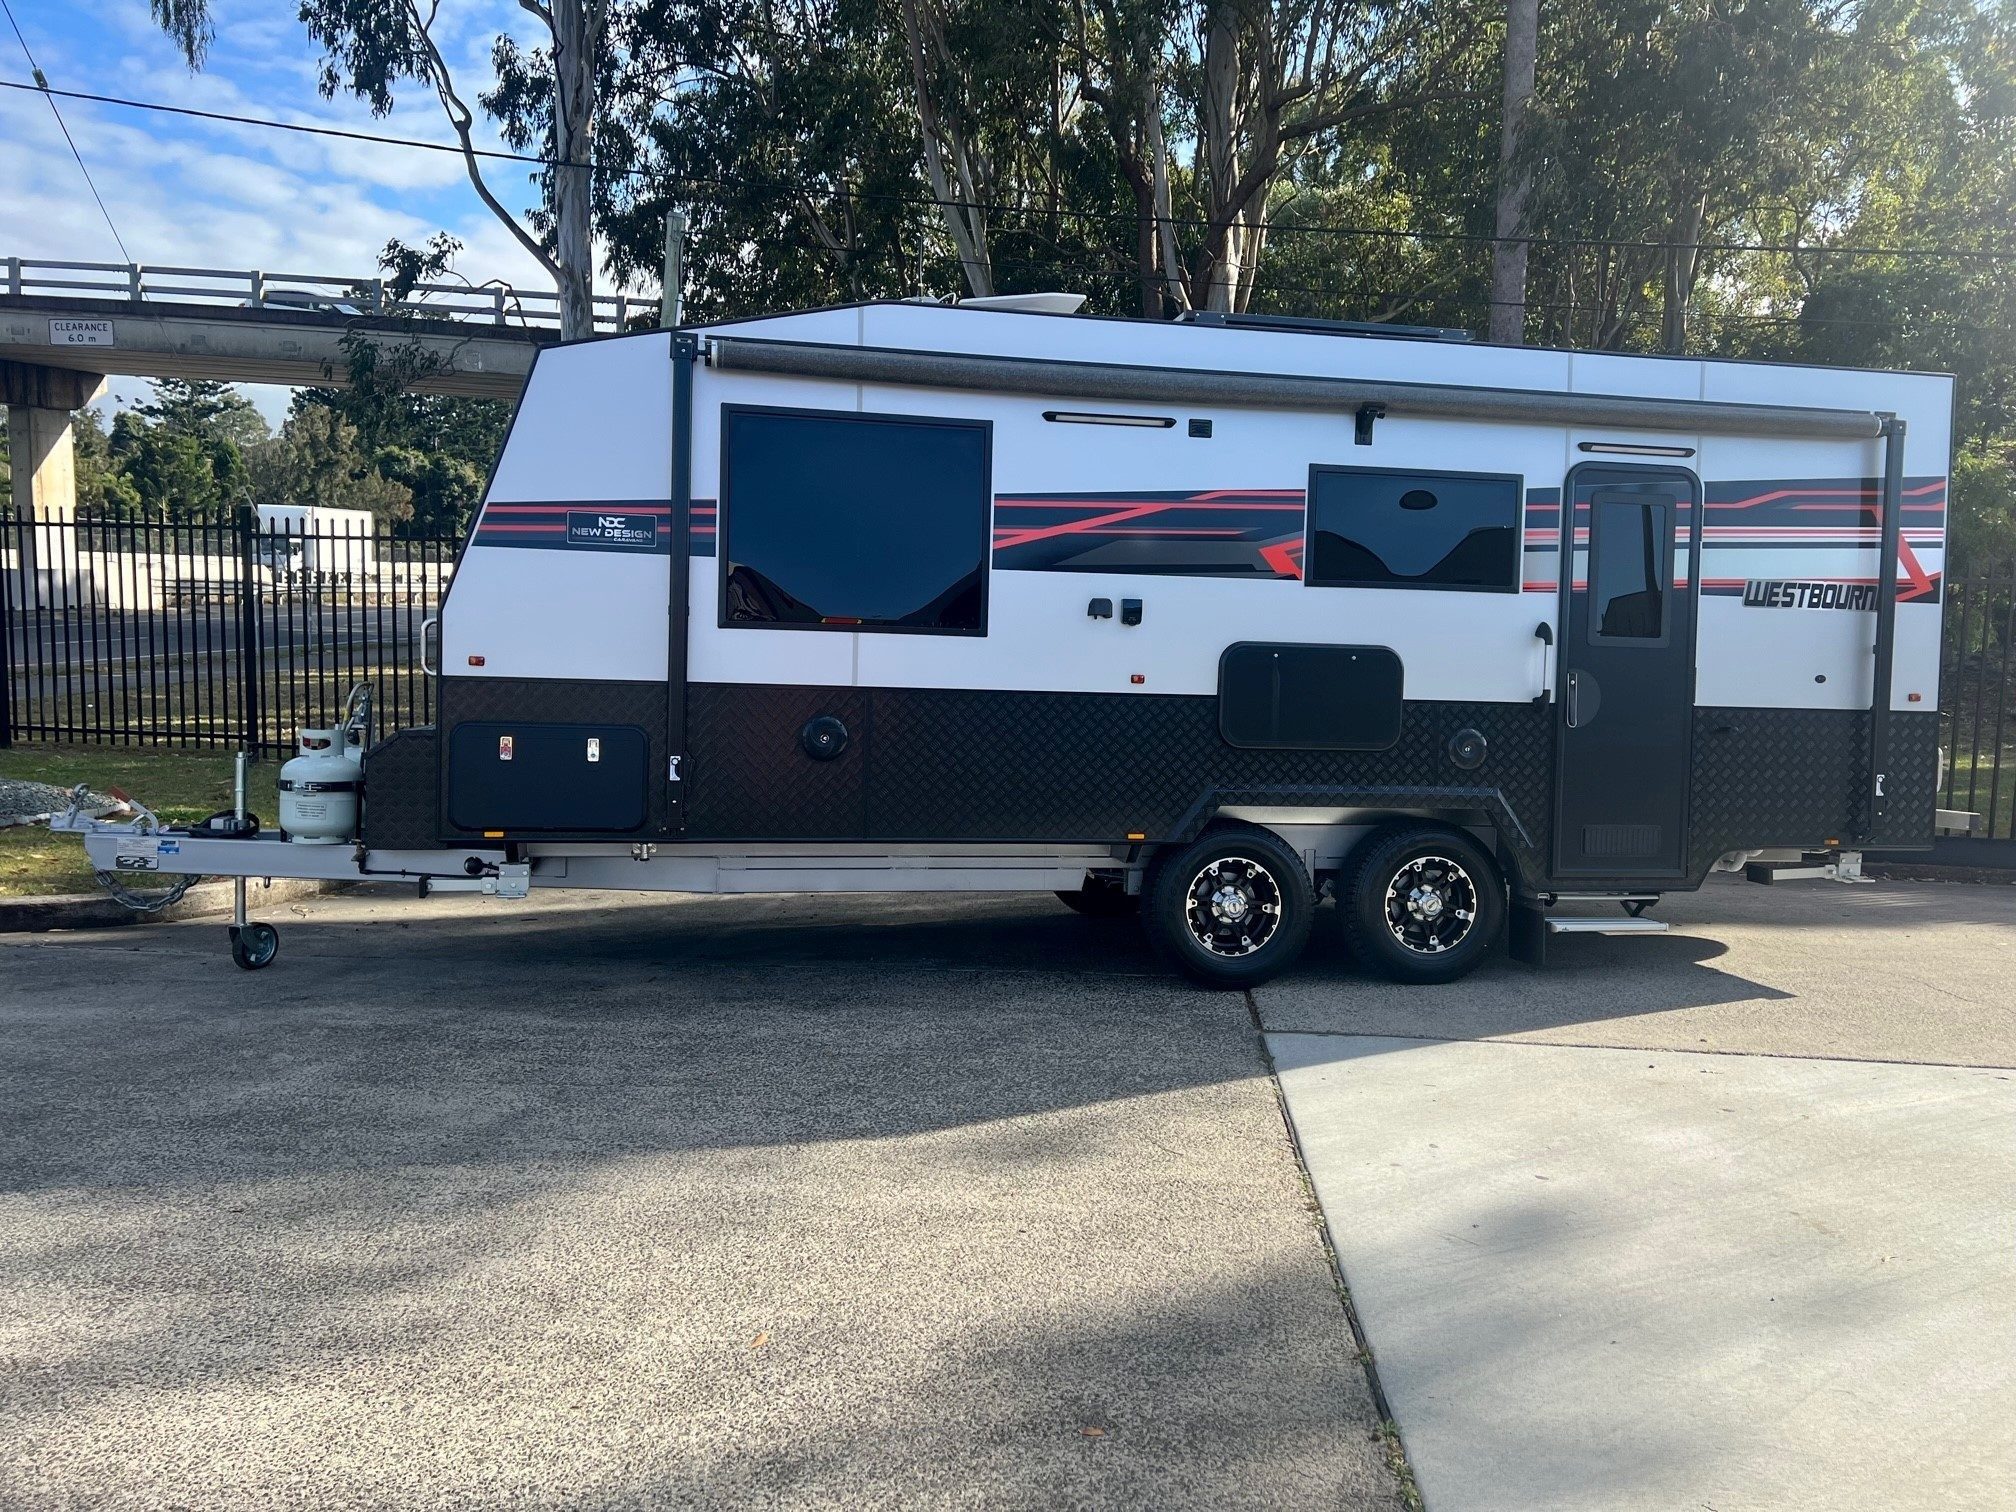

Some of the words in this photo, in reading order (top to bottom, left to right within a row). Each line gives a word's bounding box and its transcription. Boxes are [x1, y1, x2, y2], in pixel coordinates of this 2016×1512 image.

[54, 322, 109, 332] CLEARANCE
[68, 333, 84, 343] 6.0
[598, 516, 626, 528] NDC
[572, 527, 601, 537] NEW
[604, 529, 652, 539] DESIGN
[1743, 580, 1880, 611] WESTBOURN
